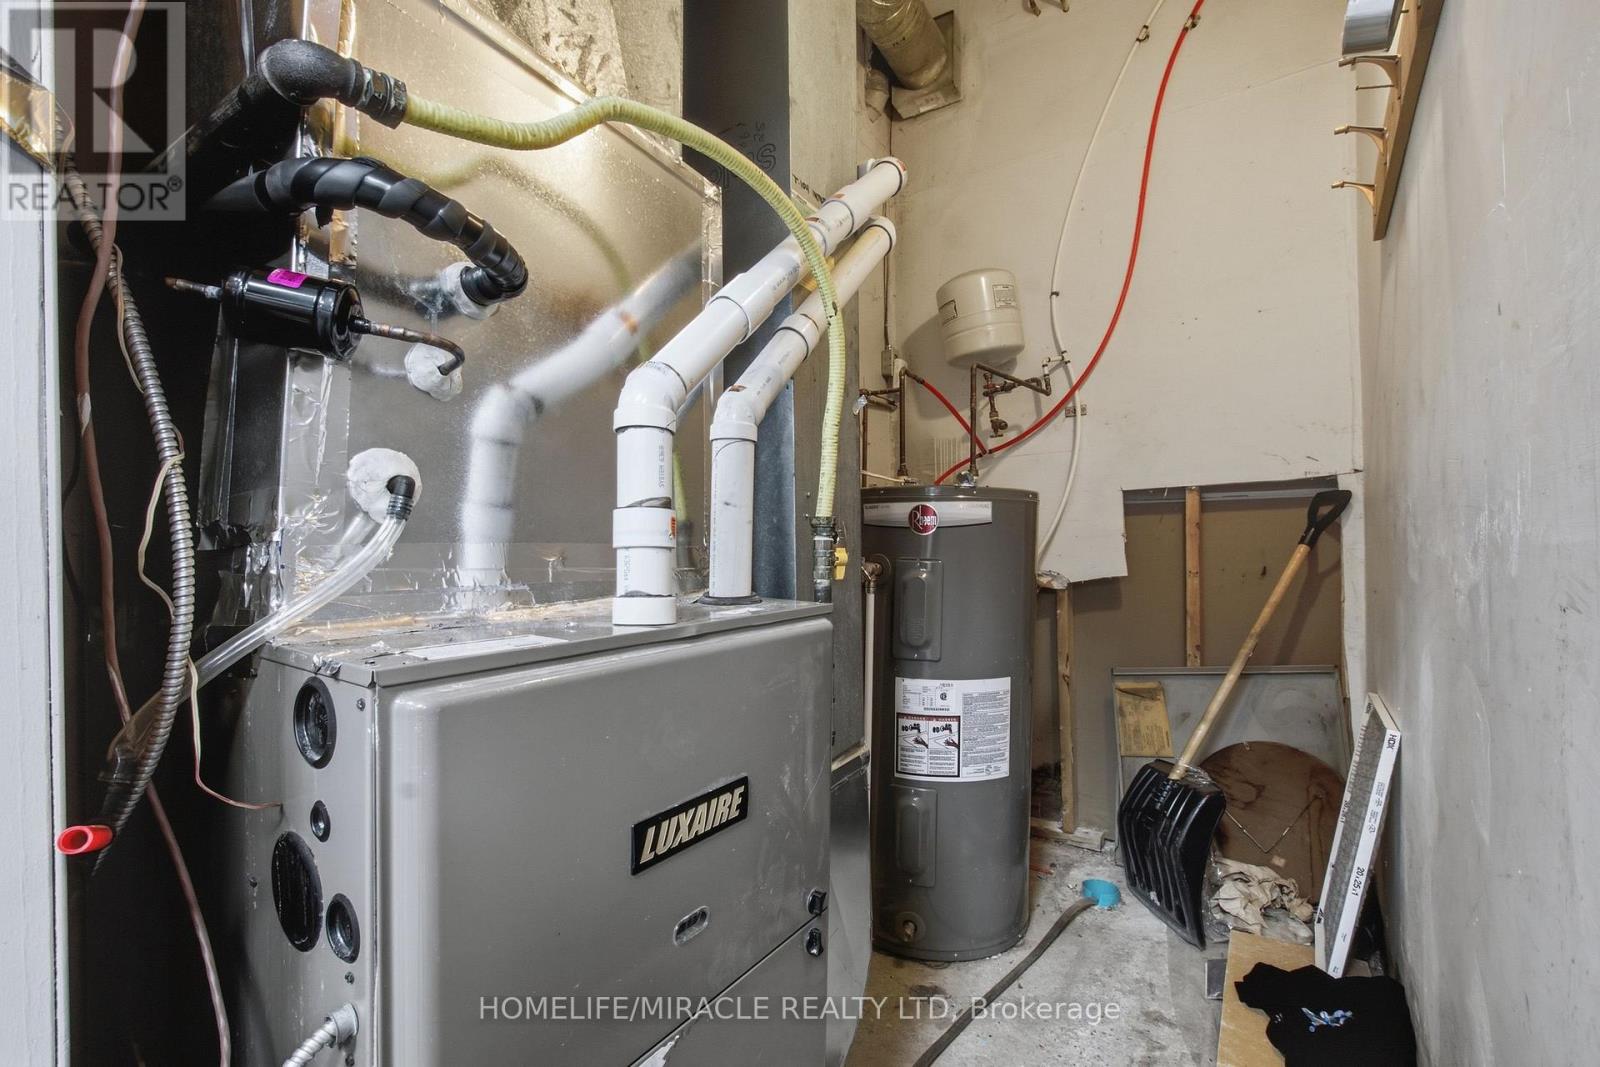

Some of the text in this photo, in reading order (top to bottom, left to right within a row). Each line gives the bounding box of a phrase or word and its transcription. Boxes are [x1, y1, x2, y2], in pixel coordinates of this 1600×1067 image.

[911, 505, 937, 530] Rheem
[1387, 734, 1398, 750] HDX
[639, 785, 745, 864] LUXAIRE
